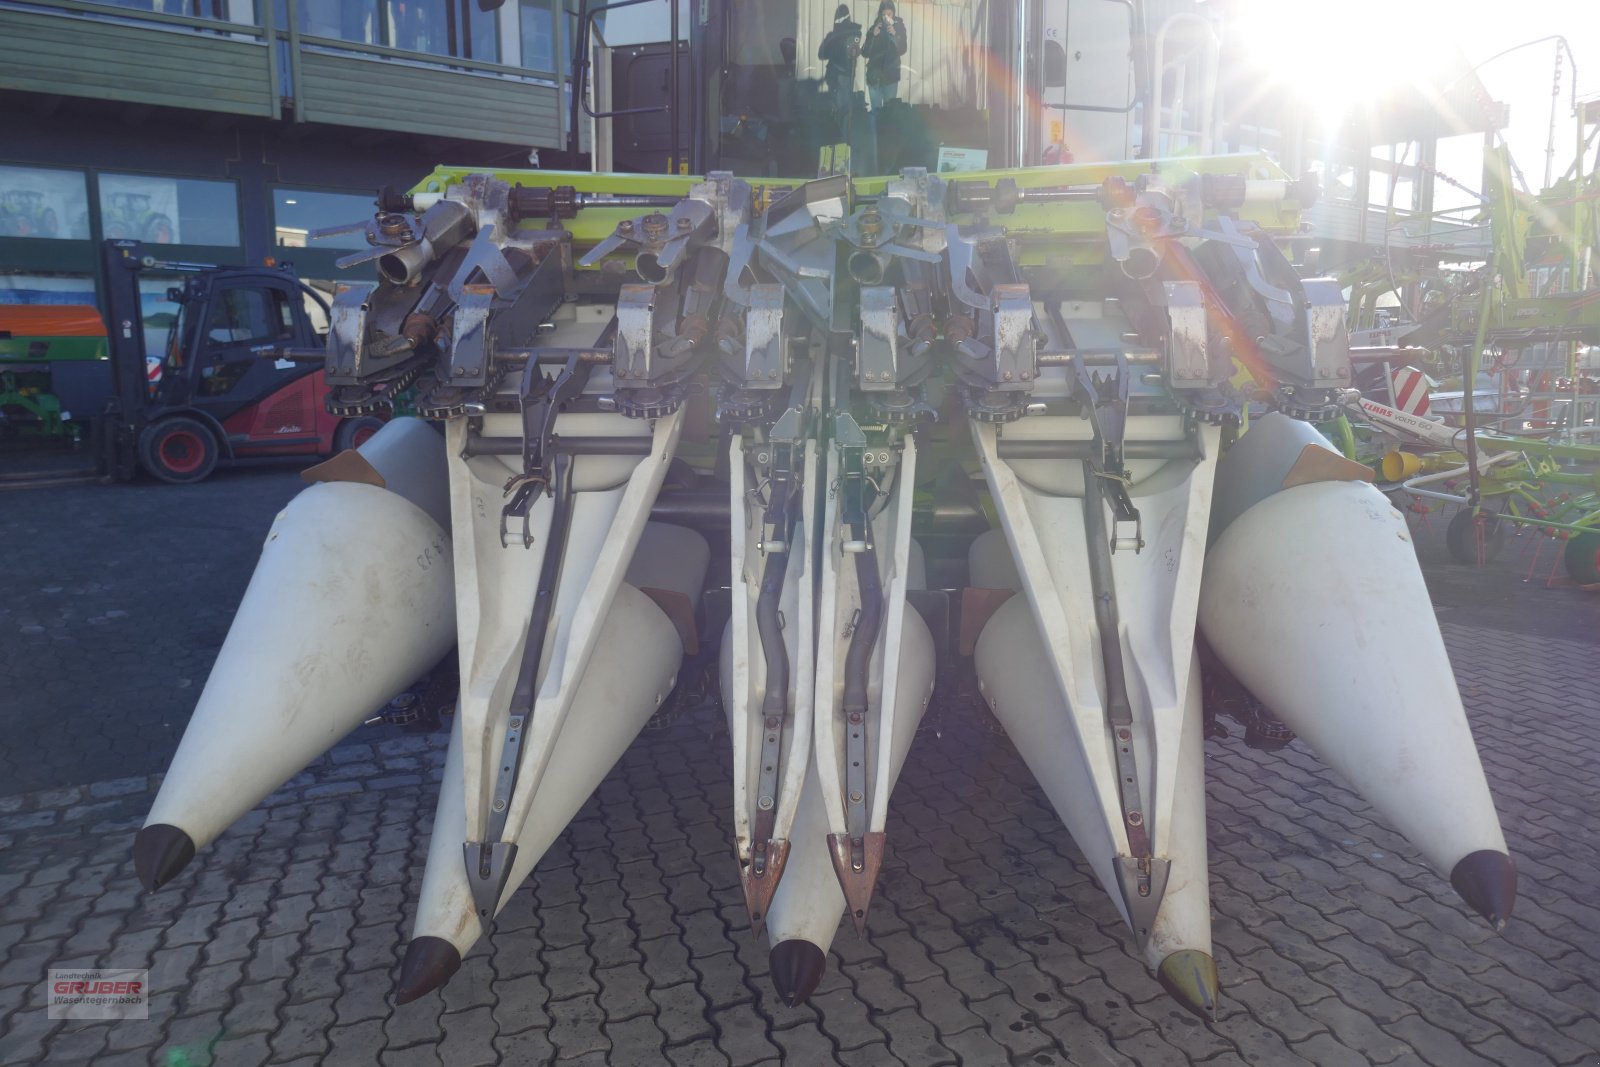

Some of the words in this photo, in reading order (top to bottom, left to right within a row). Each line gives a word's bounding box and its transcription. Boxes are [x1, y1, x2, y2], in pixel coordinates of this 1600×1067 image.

[1363, 403, 1393, 417] CLAAS
[1395, 414, 1417, 426] VOLTO
[1418, 420, 1433, 431] 60
